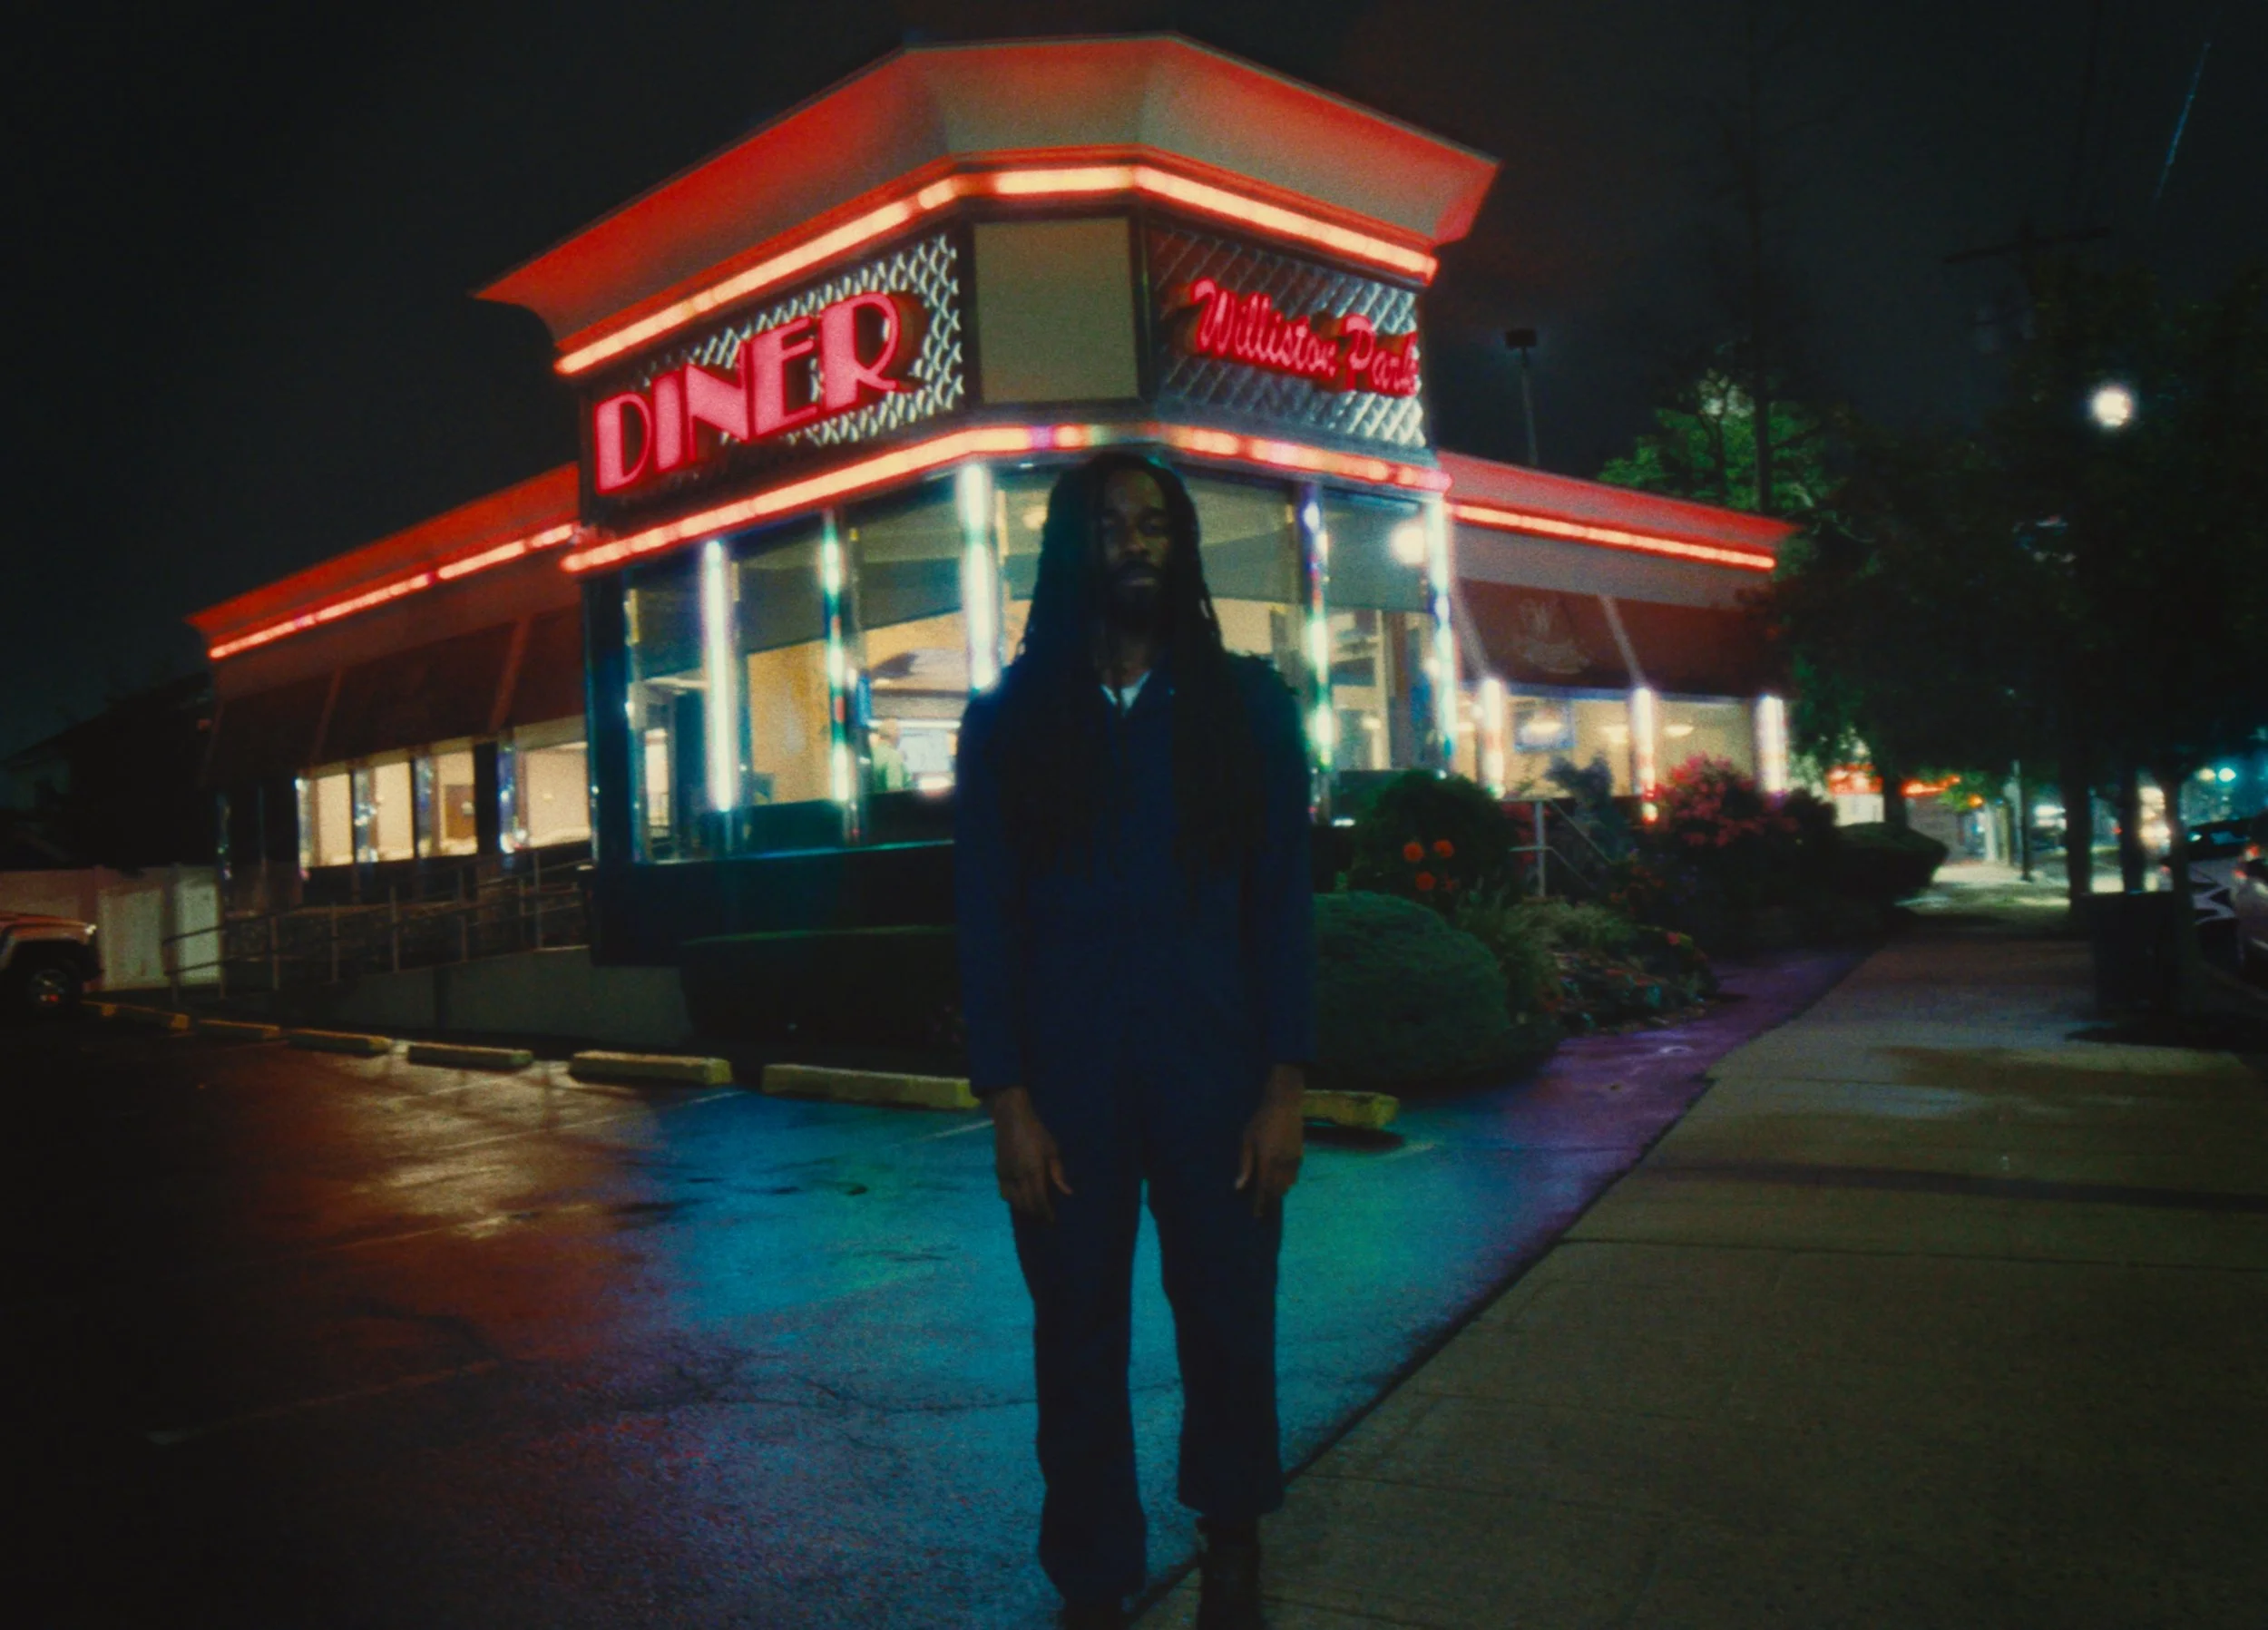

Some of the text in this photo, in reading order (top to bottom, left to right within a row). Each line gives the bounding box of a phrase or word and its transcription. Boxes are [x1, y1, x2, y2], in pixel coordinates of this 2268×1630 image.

[595, 291, 899, 493] DINER
[1190, 278, 1417, 396] Williston Park
